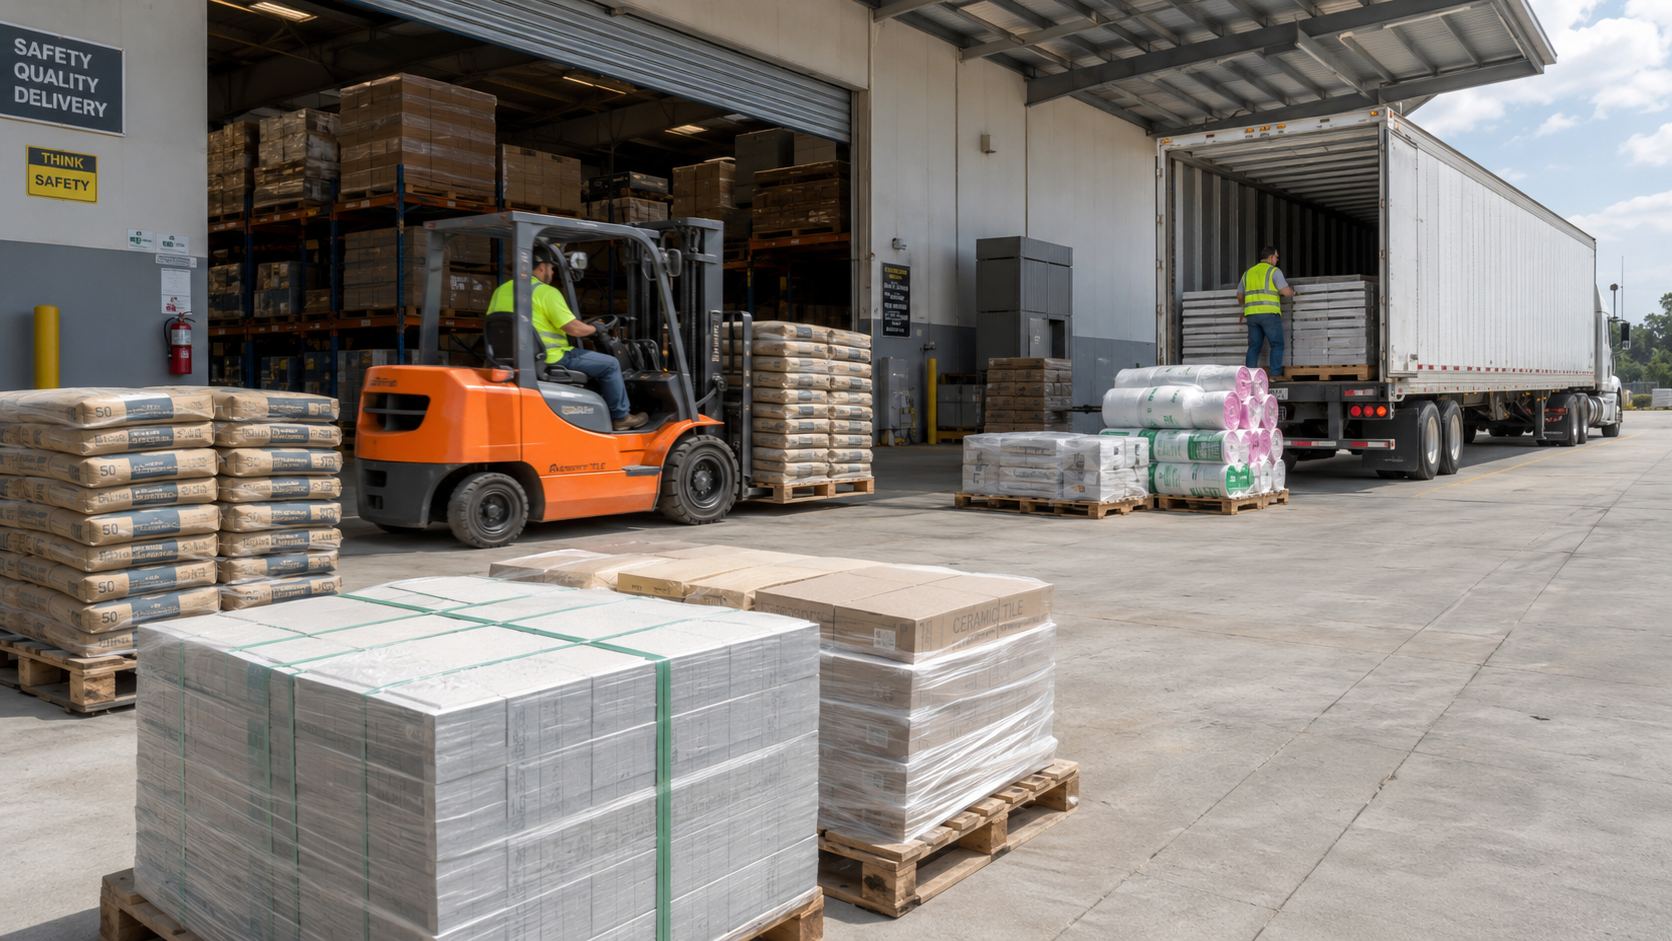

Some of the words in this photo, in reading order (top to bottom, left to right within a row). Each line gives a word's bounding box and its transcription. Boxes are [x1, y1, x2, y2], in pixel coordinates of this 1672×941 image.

[14, 38, 92, 69] SAFETY
[14, 62, 99, 93] QUALITY
[14, 86, 107, 117] DELIVERY
[41, 152, 84, 169] THINK
[35, 174, 90, 191] SAFETY
[95, 406, 112, 418] 50
[100, 464, 116, 477] 50
[102, 523, 119, 536] 50
[98, 580, 115, 594] 50
[101, 610, 118, 624] 50
[953, 608, 998, 634] CERAMIC
[1001, 600, 1023, 619] TILE
